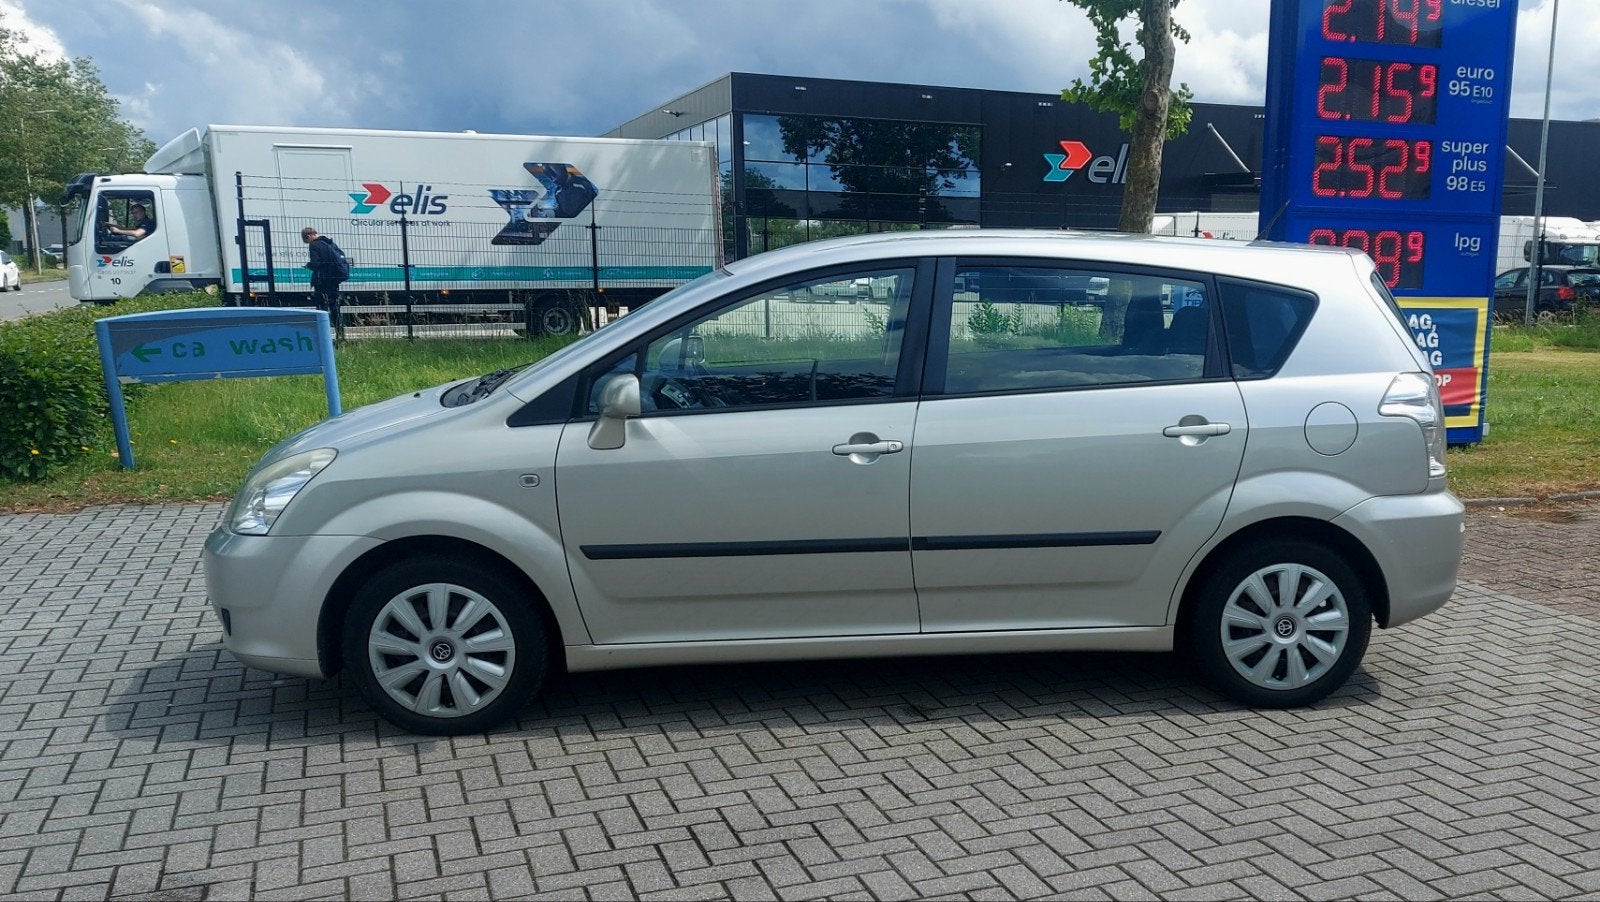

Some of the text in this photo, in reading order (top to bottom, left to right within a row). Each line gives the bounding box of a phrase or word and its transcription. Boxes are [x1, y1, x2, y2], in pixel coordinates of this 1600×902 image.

[1451, 0, 1500, 8] esel
[1456, 66, 1495, 80] euro
[1448, 80, 1493, 98] 95 E10
[1441, 141, 1490, 157] super
[1088, 143, 1130, 184] el
[1452, 155, 1487, 174] plus
[1446, 175, 1486, 192] 98 E5
[390, 184, 448, 215] elis
[351, 219, 383, 227] Circular
[432, 219, 451, 227] work
[1454, 232, 1481, 252] lpg
[112, 256, 135, 267] elis
[110, 277, 121, 285] 10
[1408, 314, 1437, 333] AG,
[229, 331, 313, 356] wash
[1416, 332, 1439, 348] AG
